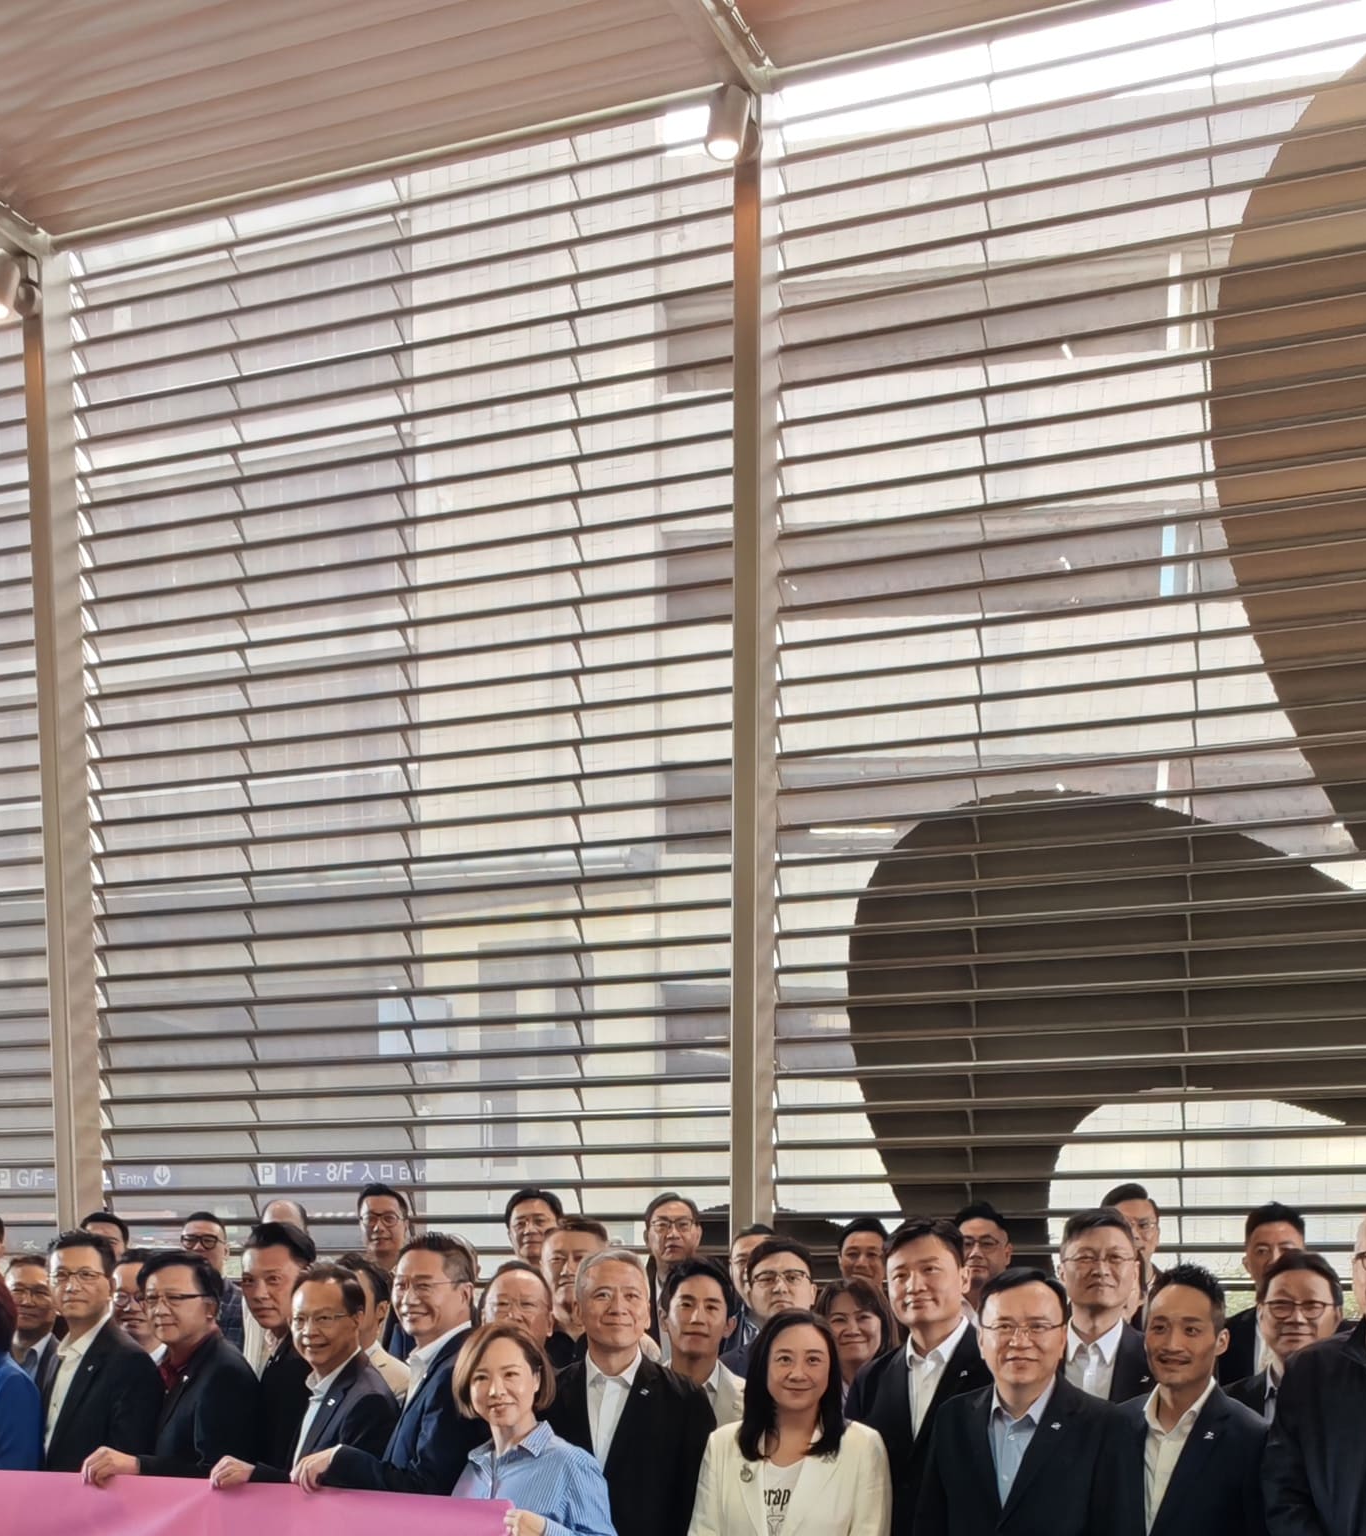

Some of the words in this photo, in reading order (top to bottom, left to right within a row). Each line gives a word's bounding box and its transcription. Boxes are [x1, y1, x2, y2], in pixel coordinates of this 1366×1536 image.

[17, 1168, 44, 1187] G/F
[118, 1172, 148, 1187] Entry
[259, 1163, 276, 1184] P
[283, 1164, 309, 1182] 1/F
[326, 1162, 354, 1182] 8/F
[360, 1163, 394, 1182] 入口
